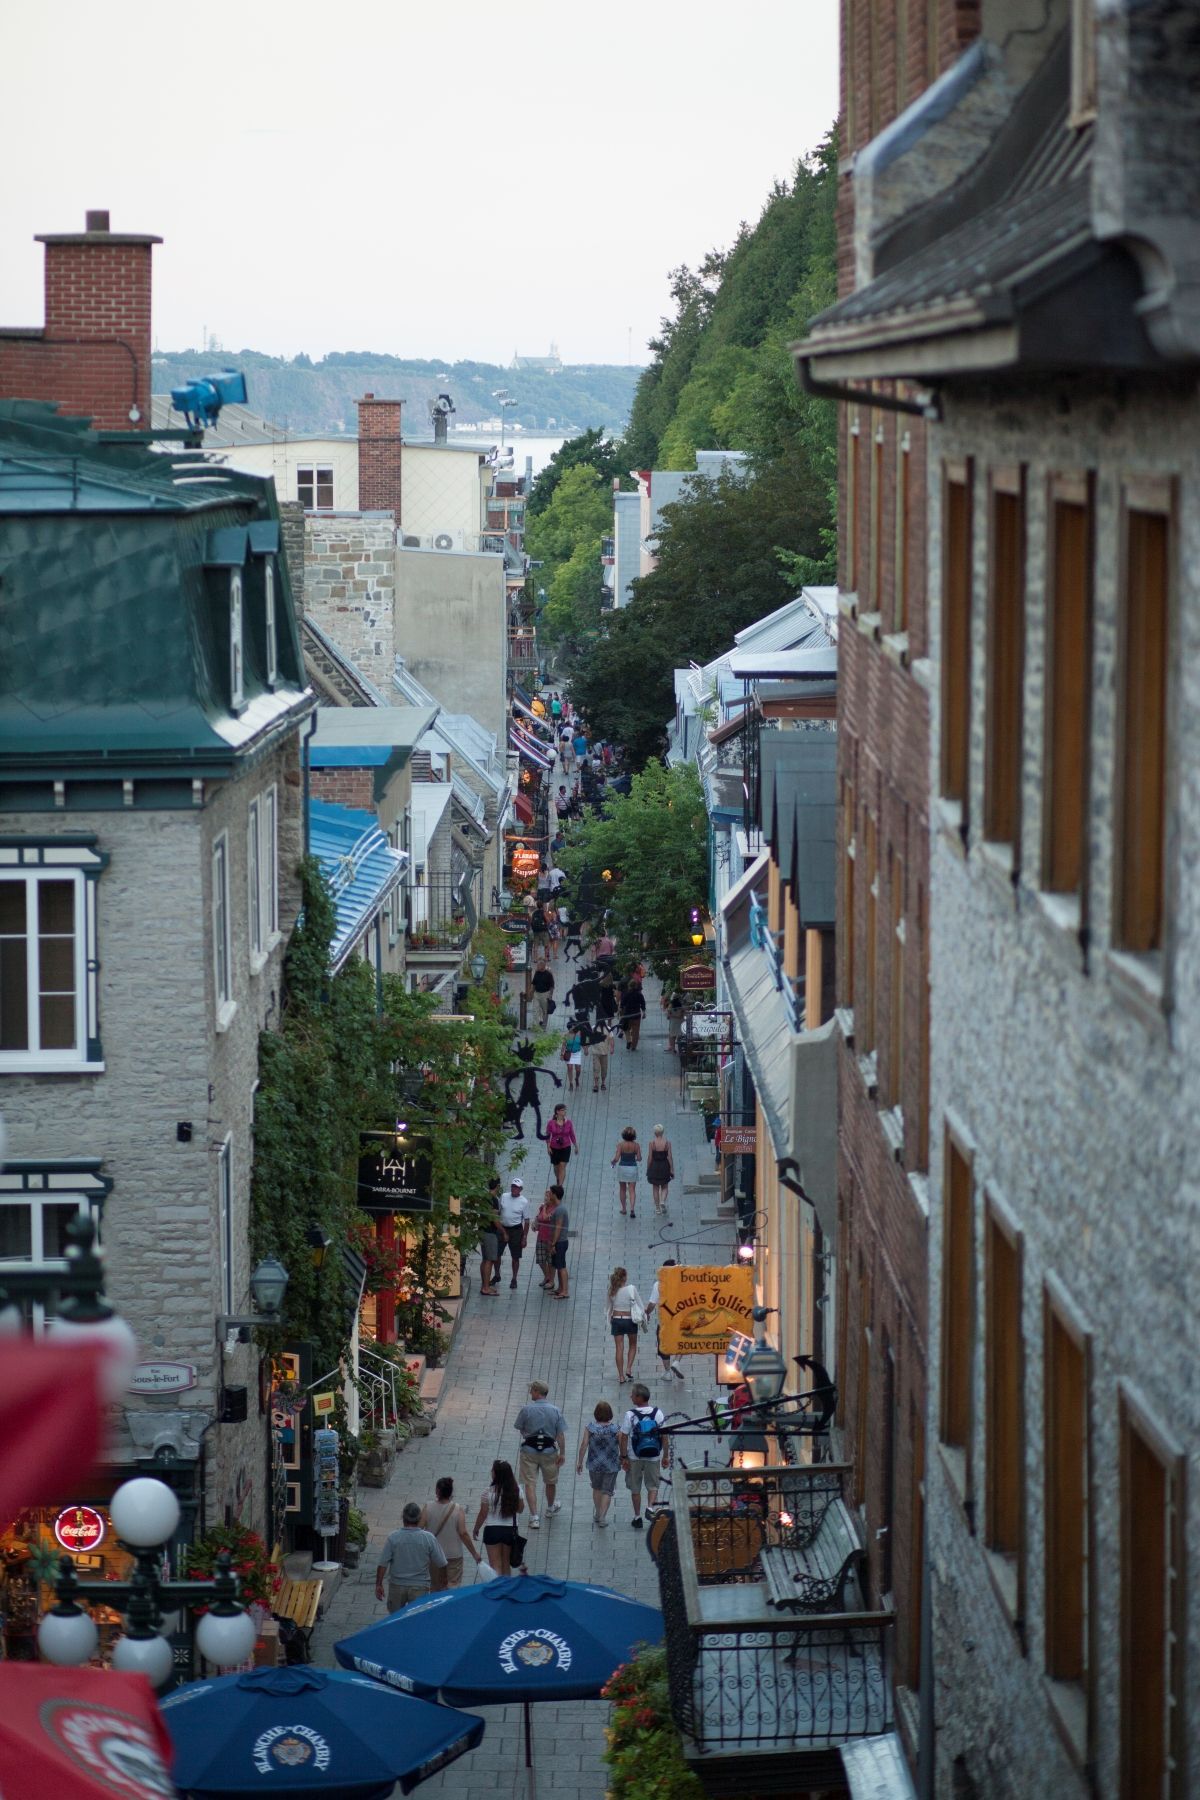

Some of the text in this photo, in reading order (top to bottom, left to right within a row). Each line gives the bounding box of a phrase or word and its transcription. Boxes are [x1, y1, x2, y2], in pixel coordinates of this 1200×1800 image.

[724, 1134, 734, 1143] Le
[681, 1269, 731, 1286] boutique
[660, 1292, 706, 1319] Louis
[677, 1338, 729, 1350] souvenir
[131, 1375, 179, 1383] Sous-le-Fort
[498, 1629, 572, 1674] BLANCHE CHAMBLY
[253, 1725, 330, 1774] BLANCHE CHAMBLY
